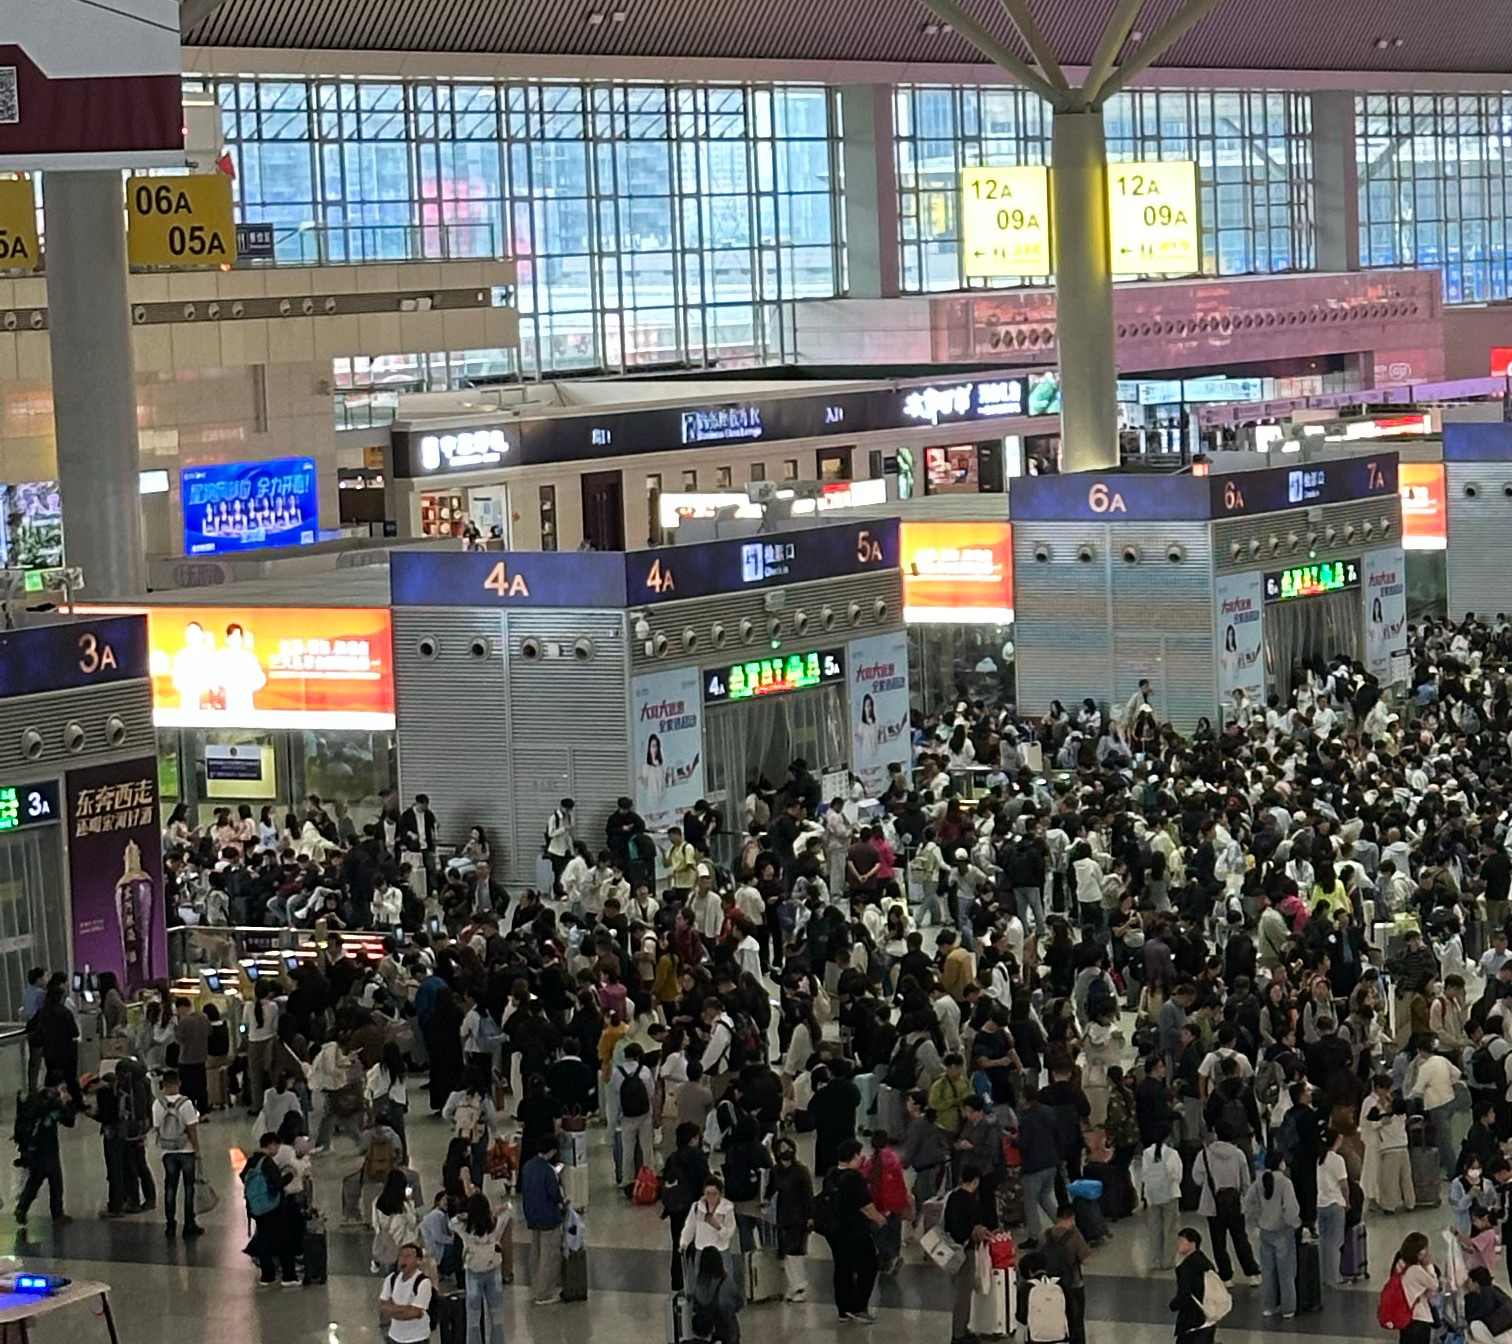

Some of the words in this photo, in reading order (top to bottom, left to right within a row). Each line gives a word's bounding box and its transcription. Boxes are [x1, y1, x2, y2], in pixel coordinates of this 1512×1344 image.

[971, 179, 1012, 199] 12A
[1117, 175, 1160, 196] 12A
[135, 185, 192, 215] 06A
[996, 209, 1040, 230] 09A
[1143, 205, 1188, 226] 09A
[0, 230, 28, 259] 5A
[168, 225, 226, 256] 05A
[1367, 463, 1385, 489] 7A
[1089, 482, 1127, 513] 6A
[1224, 481, 1245, 509] 6A
[857, 531, 883, 563] 5A
[484, 561, 530, 597] 4A
[646, 558, 675, 593] 4A
[78, 633, 118, 674] 3A
[825, 656, 840, 676] 5A
[709, 676, 725, 696] 4A
[28, 791, 50, 817] 3A
[75, 778, 153, 817] 东奔西走
